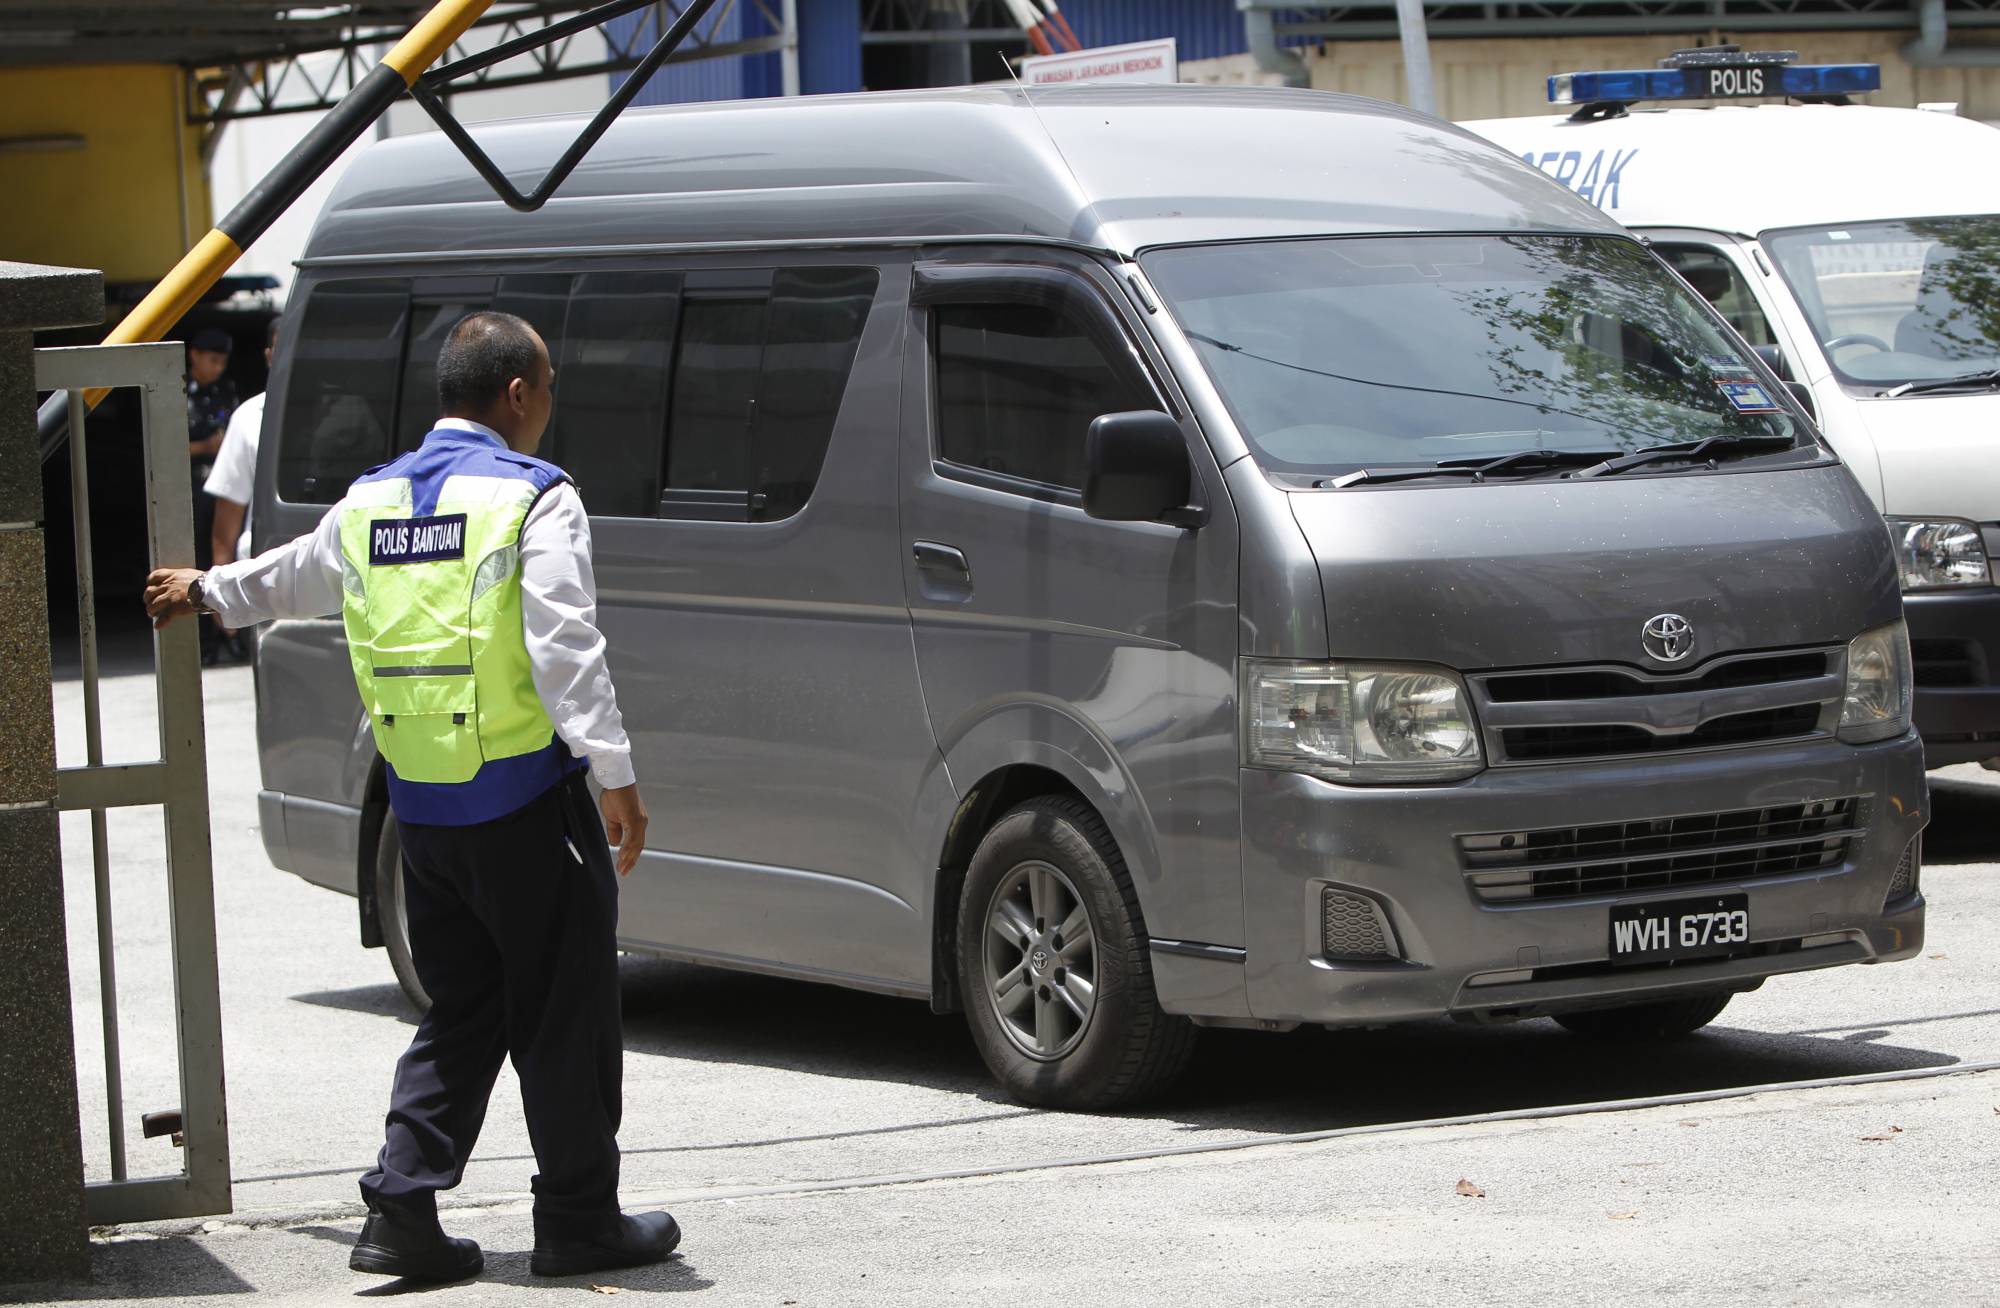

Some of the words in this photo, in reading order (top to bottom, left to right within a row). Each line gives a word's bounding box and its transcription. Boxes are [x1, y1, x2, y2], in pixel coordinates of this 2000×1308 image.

[1076, 62, 1120, 80] LARANGAN
[1123, 56, 1163, 73] MEROKOK
[1710, 69, 1764, 95] POLIS
[375, 527, 409, 555] POLIS
[412, 522, 462, 554] BANTUAN
[1614, 917, 1670, 953] WVH
[1680, 910, 1748, 947] 6733
